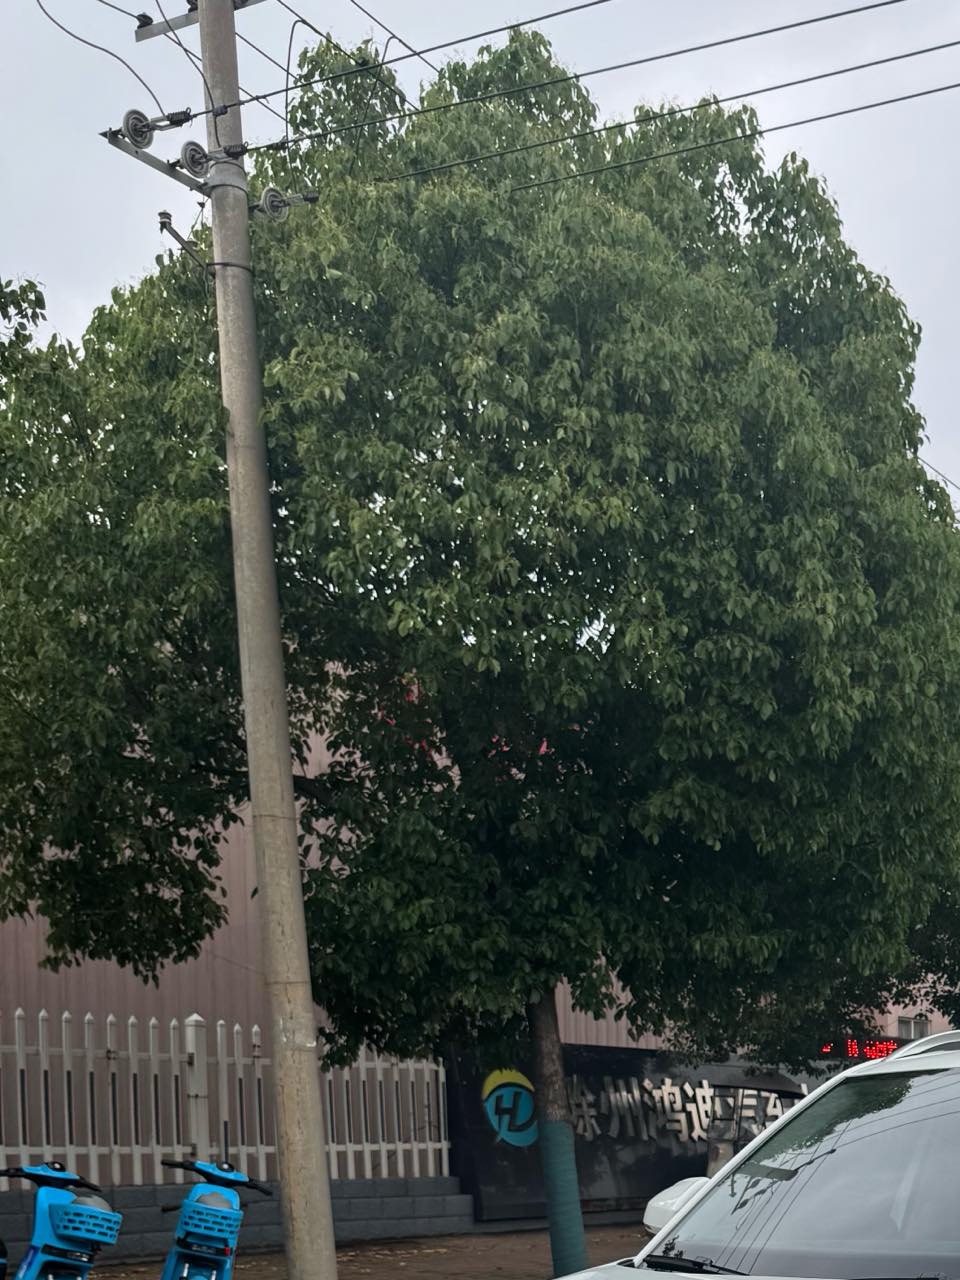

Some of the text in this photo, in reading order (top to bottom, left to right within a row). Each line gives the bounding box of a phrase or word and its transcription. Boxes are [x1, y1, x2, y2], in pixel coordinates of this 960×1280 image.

[567, 1074, 808, 1142] 徐州鸿迪汽车
